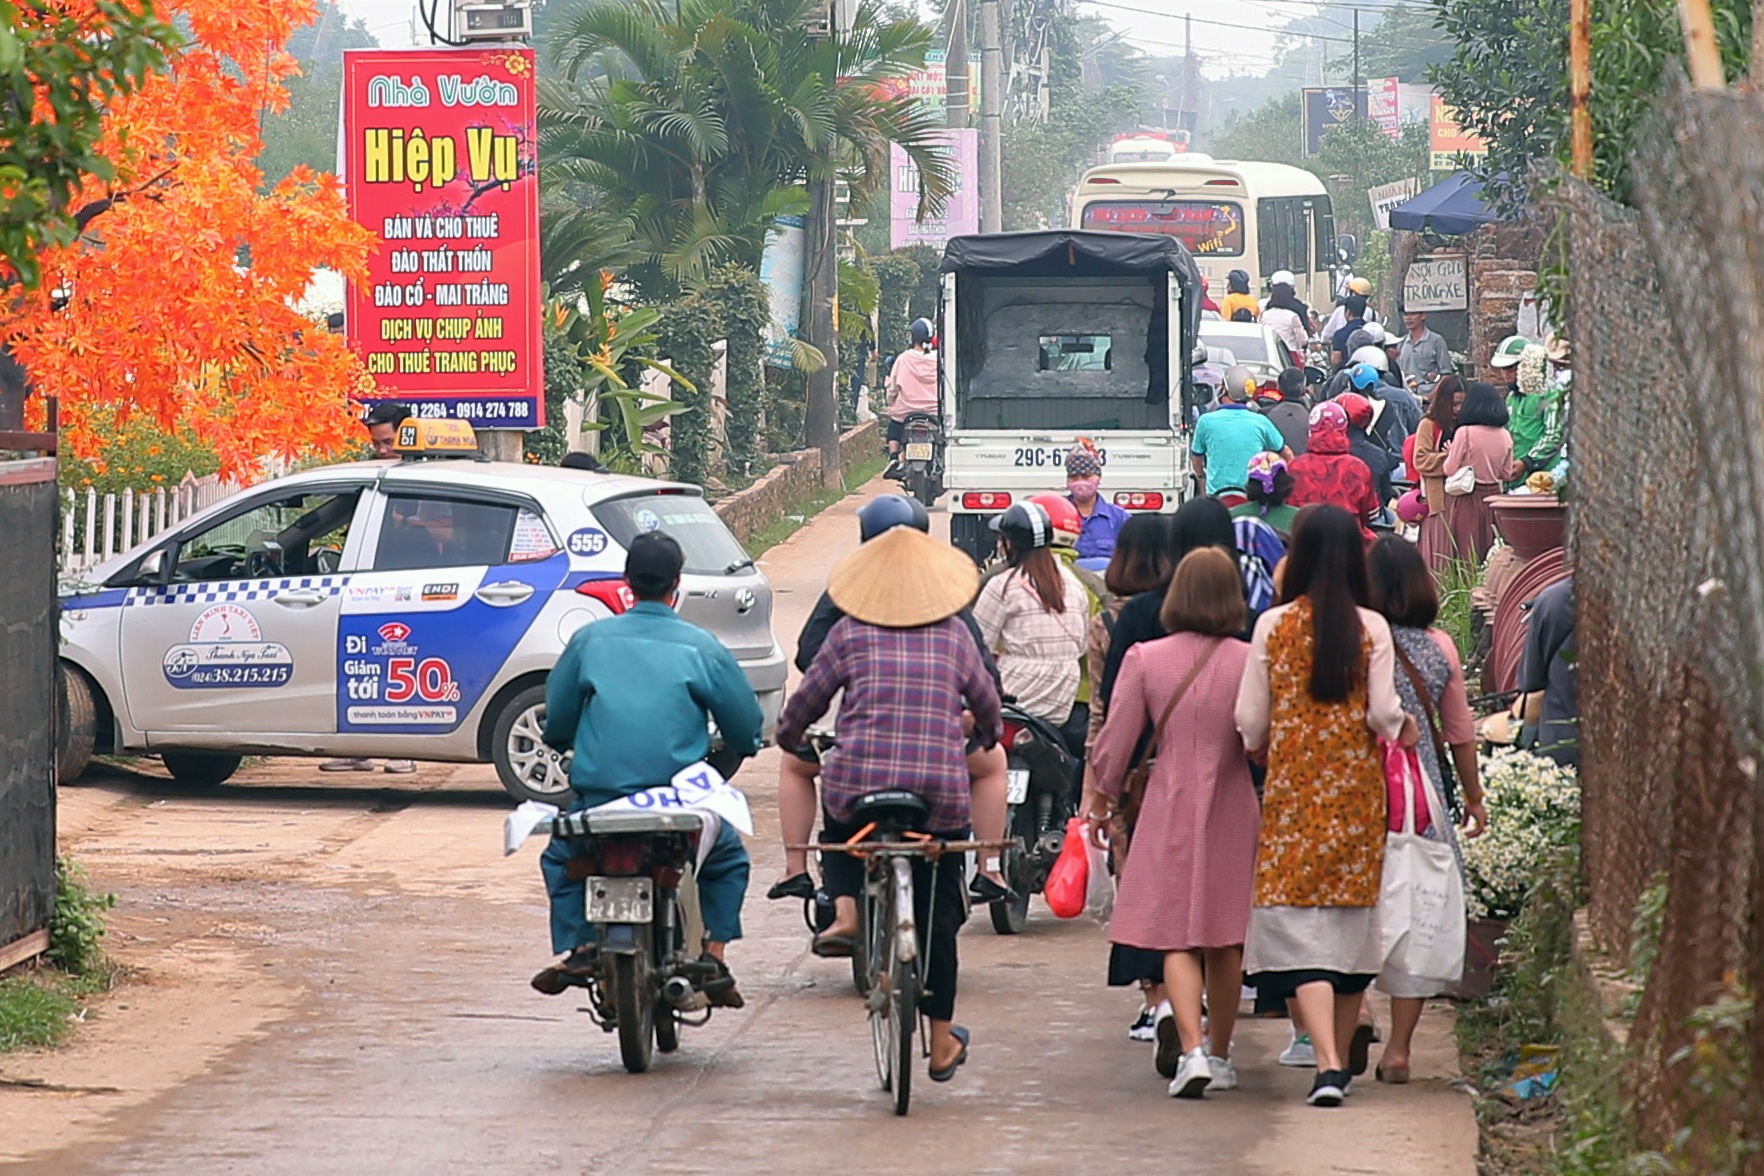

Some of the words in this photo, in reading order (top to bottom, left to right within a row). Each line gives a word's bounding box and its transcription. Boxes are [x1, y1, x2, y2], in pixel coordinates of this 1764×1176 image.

[369, 75, 430, 107] Nhà
[437, 75, 518, 107] Vườn
[365, 128, 455, 192] Hiệp
[466, 128, 518, 191] Vụ
[384, 214, 412, 238] BÁN
[415, 213, 432, 238] VÀ
[436, 217, 463, 238] CHO
[466, 212, 498, 238] THUÊ
[391, 247, 418, 272] ĐÀO
[422, 244, 453, 272] THẤT
[457, 243, 492, 271] THỐN
[1198, 238, 1223, 253] Wifi
[375, 281, 401, 306] ĐÀO
[405, 276, 424, 306] CỔ
[435, 284, 461, 305] MAI
[465, 277, 508, 305] TRẮNG
[381, 319, 412, 345] DỊCH
[415, 318, 433, 343] VỤ
[436, 318, 472, 343] CHỤP
[475, 310, 502, 338] ẢNH
[368, 352, 394, 373] CHO
[398, 348, 430, 373] THUÊ
[434, 352, 477, 373] TRANG
[481, 352, 517, 376] PHỤC
[421, 402, 446, 418] 2264
[456, 402, 482, 418] 0914
[485, 402, 506, 418] 274
[508, 402, 529, 417] 788
[572, 534, 604, 552] 555
[346, 635, 367, 654] Đi
[344, 660, 380, 675] Giảm
[348, 676, 379, 699] tới
[353, 710, 377, 720] thanh
